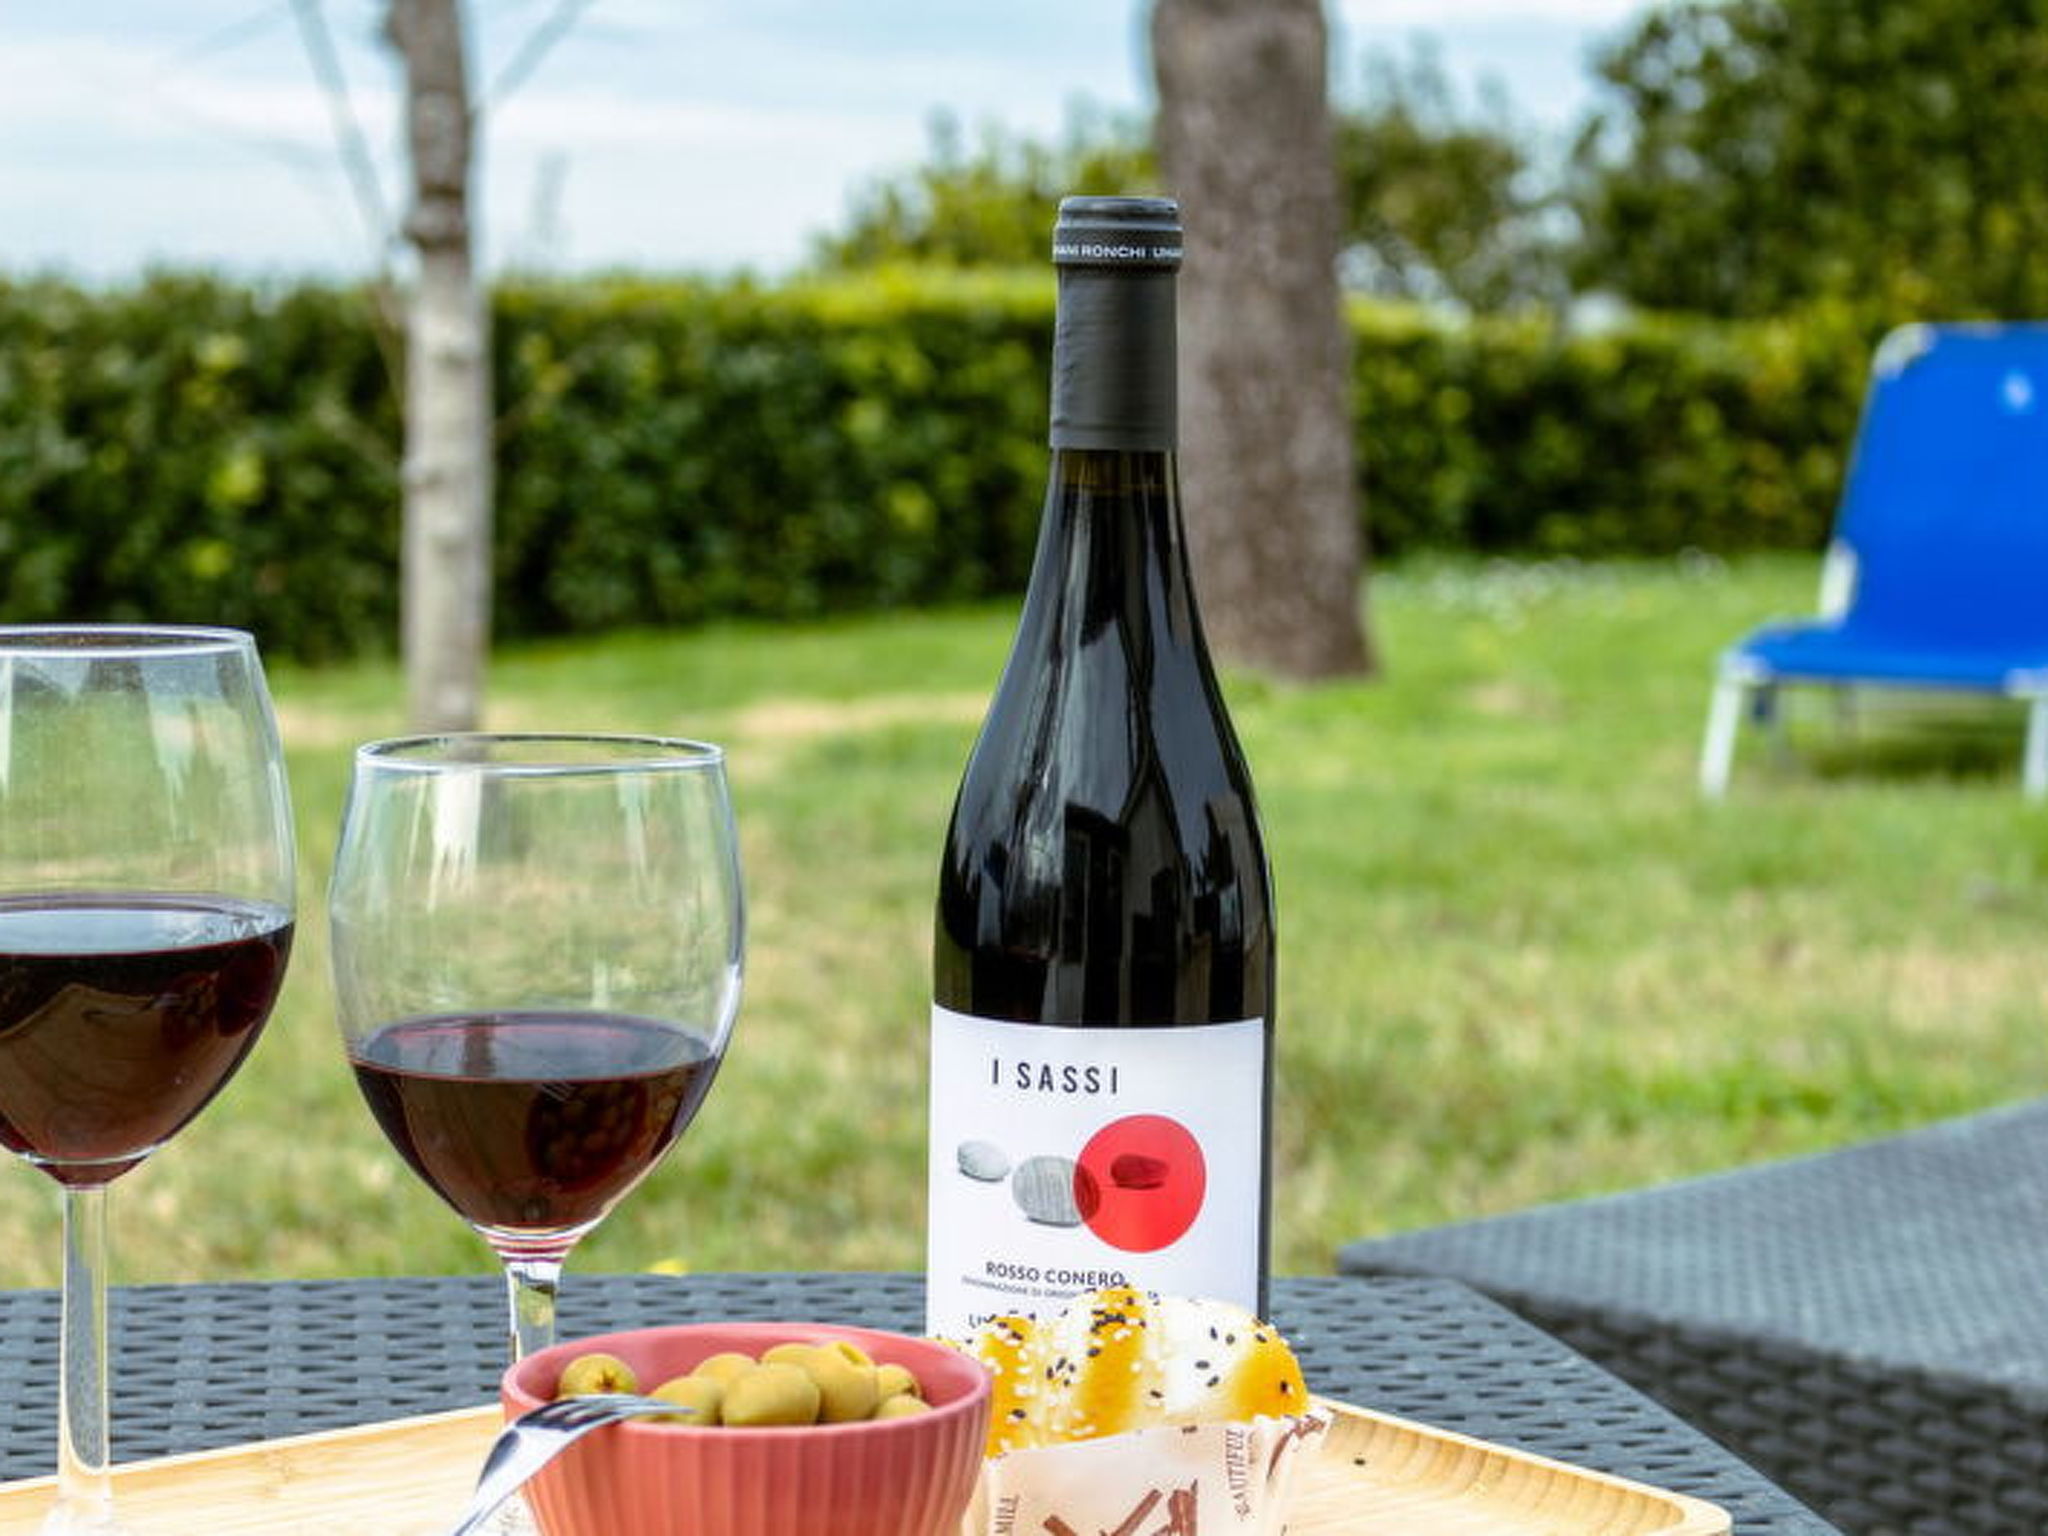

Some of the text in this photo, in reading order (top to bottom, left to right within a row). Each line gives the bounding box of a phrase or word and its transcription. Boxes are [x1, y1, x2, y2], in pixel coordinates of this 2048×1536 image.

[1081, 244, 1146, 259] RONCHI
[992, 1058, 1118, 1095] I SASSI
[986, 1261, 1126, 1288] ROSSO CONERO
